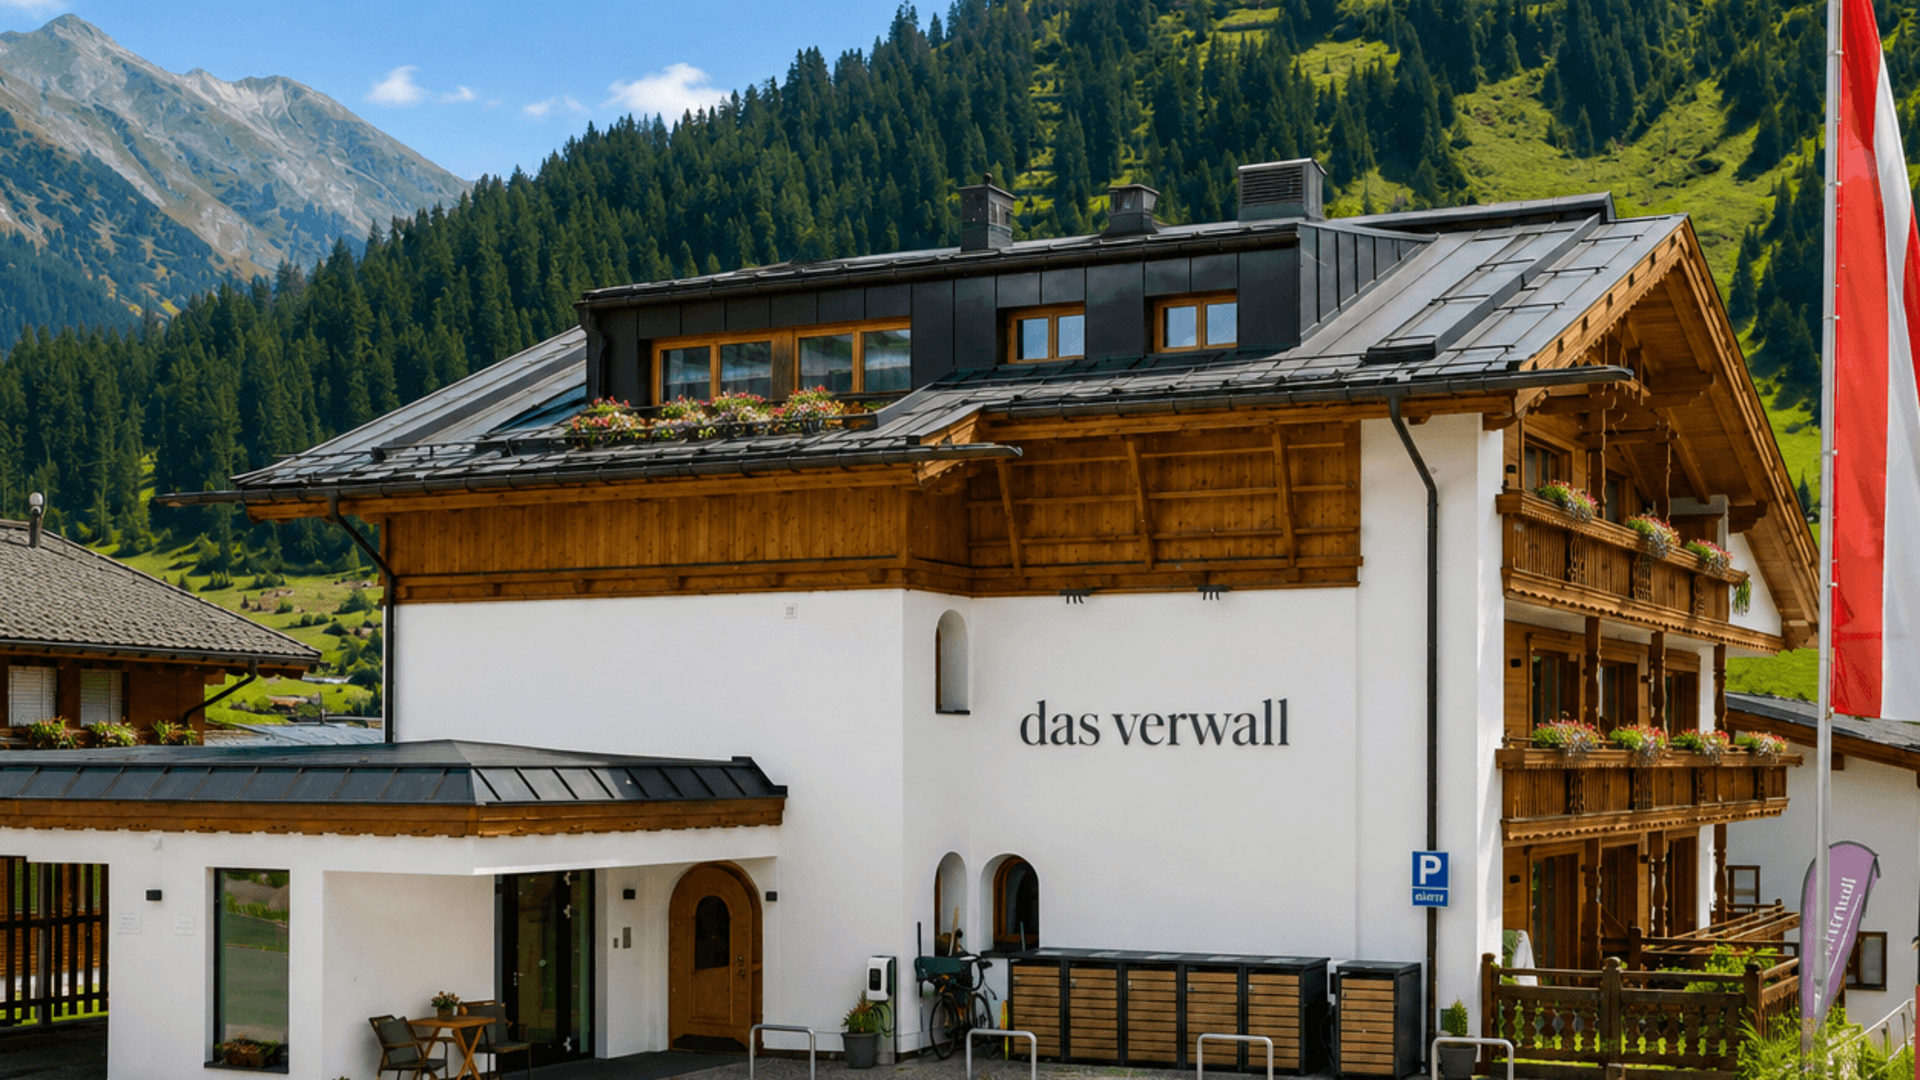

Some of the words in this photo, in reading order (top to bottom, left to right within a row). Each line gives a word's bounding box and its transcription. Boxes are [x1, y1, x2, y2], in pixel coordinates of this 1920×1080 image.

[1019, 699, 1101, 747] das
[1111, 698, 1290, 747] verwall
[1420, 855, 1441, 885] P
